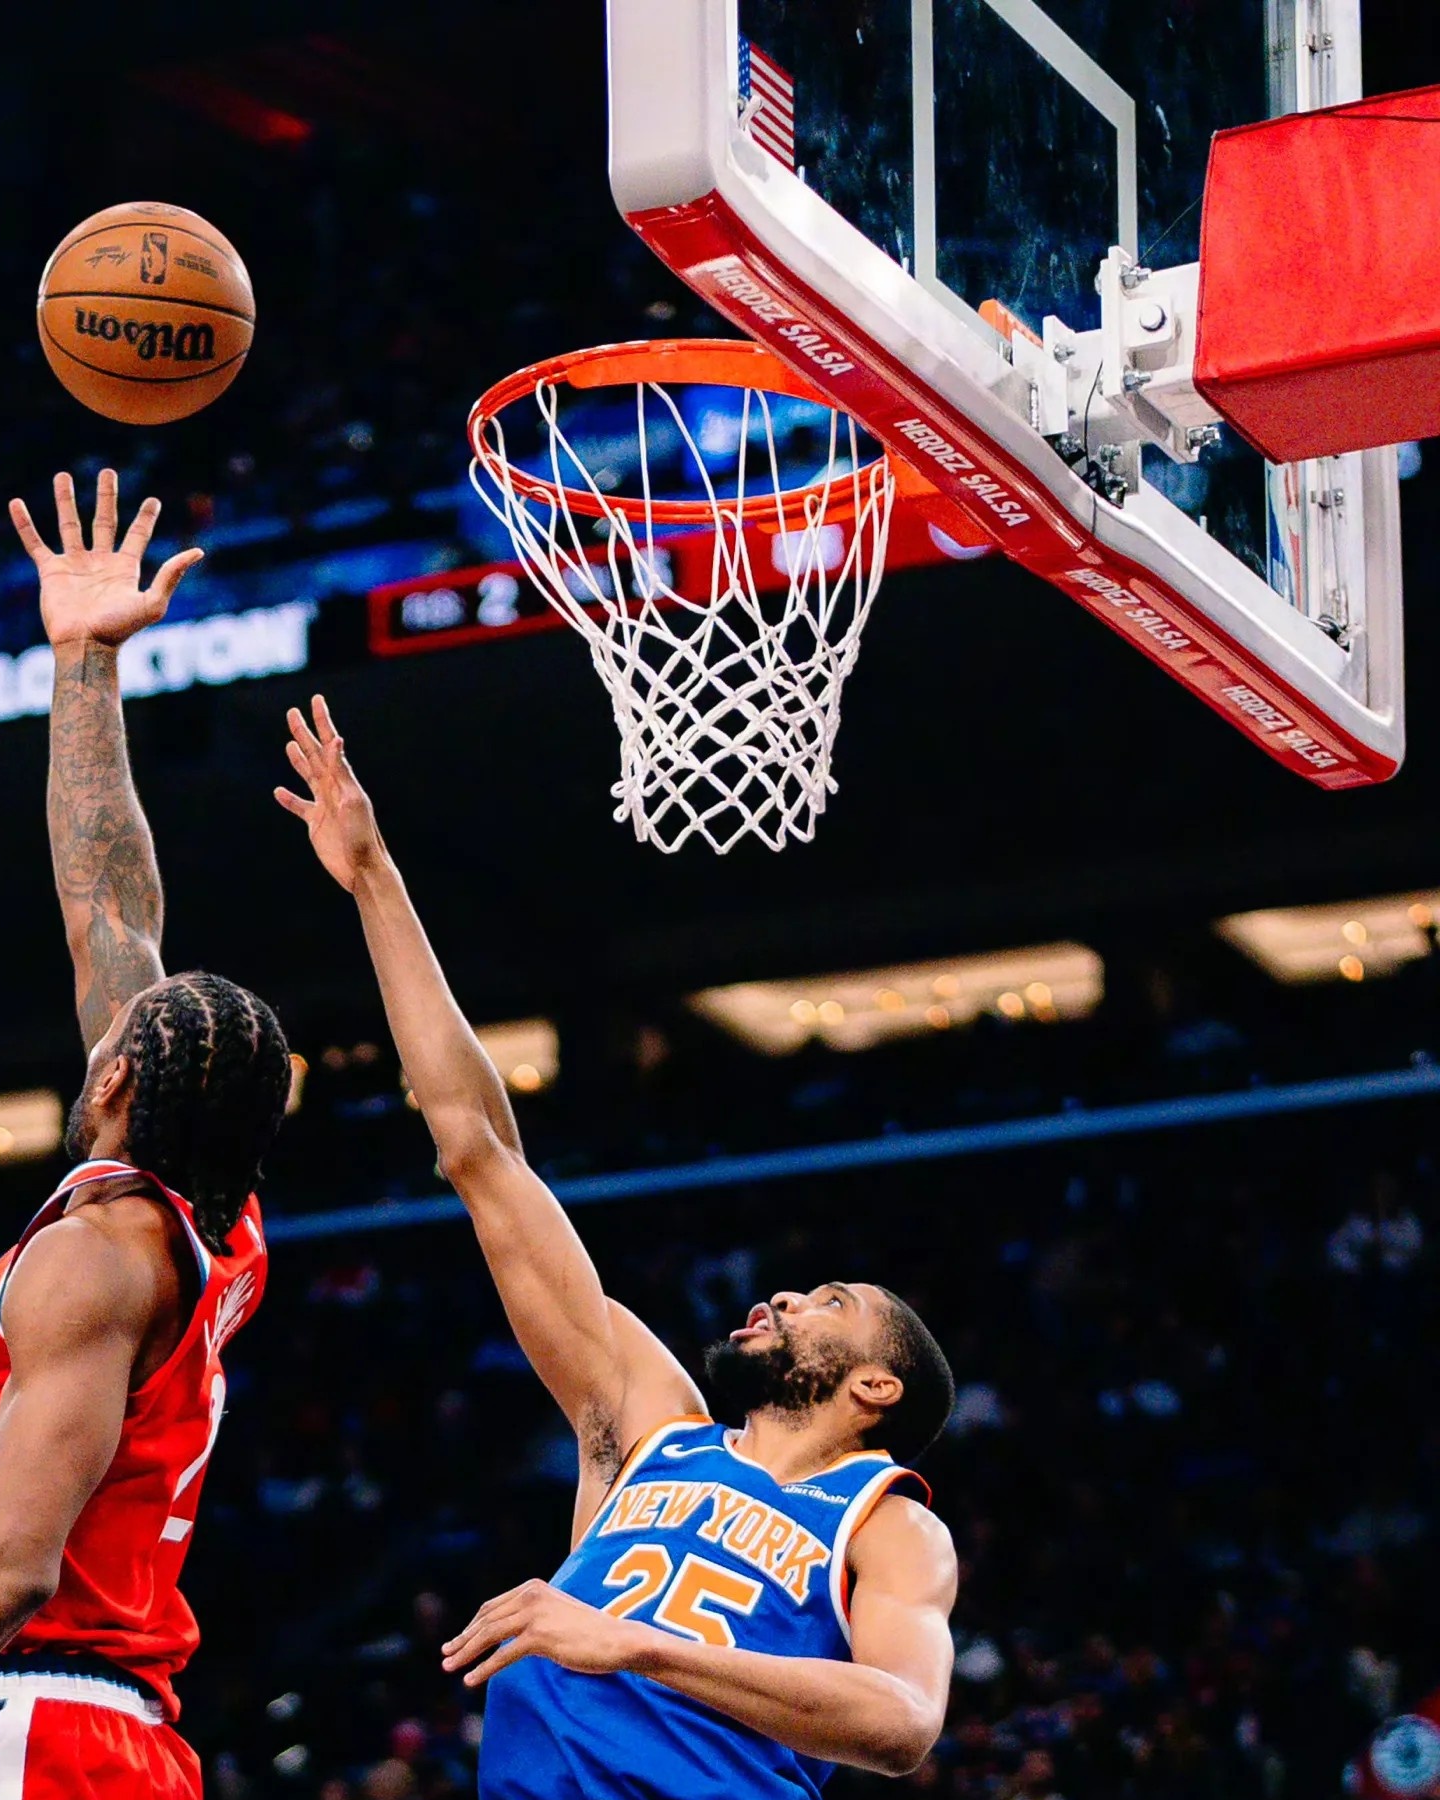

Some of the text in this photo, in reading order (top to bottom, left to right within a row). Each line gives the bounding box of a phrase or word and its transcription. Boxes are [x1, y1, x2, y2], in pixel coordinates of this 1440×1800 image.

[74, 307, 216, 362] Wilson
[710, 262, 856, 377] HERDEZ SALSA
[893, 418, 1031, 527] HERDEZ SALSA
[1064, 568, 1191, 651] HERDEZ SALSA
[1220, 684, 1340, 770] HERDEZ SALSA
[597, 1480, 832, 1607] NEW YORK
[600, 1543, 764, 1649] 25
